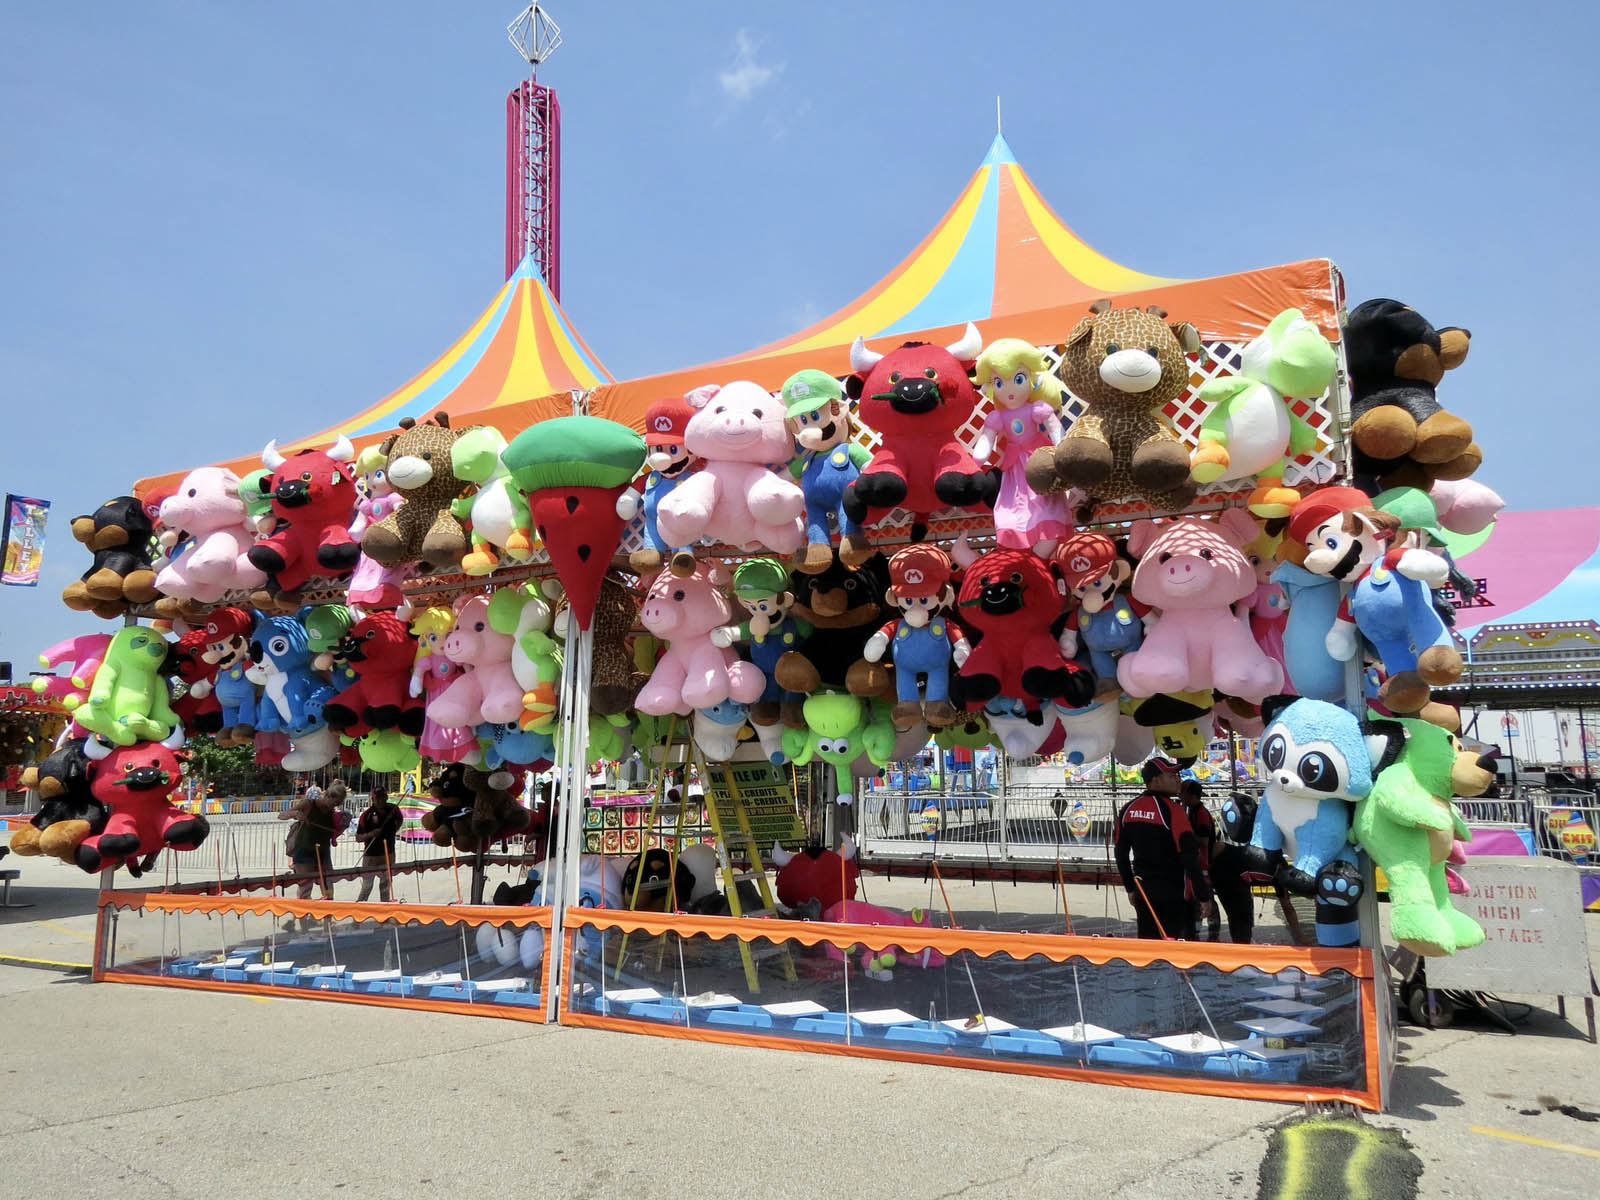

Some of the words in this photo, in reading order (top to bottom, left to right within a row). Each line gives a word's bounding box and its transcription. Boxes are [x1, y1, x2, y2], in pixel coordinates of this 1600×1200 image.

[656, 418, 671, 430] M
[20, 504, 36, 572] TALLEY
[1073, 557, 1089, 570] M
[906, 571, 922, 581] M
[711, 770, 750, 783] BOTLE
[752, 768, 767, 780] UP
[744, 788, 778, 798] CREDITS
[755, 797, 788, 806] CREDITS
[1129, 810, 1155, 820] TALLEY
[1562, 832, 1593, 844] EXIT
[1461, 885, 1537, 899] AUTION
[1478, 905, 1521, 920] HIGH
[1484, 928, 1544, 943] LTAGE
